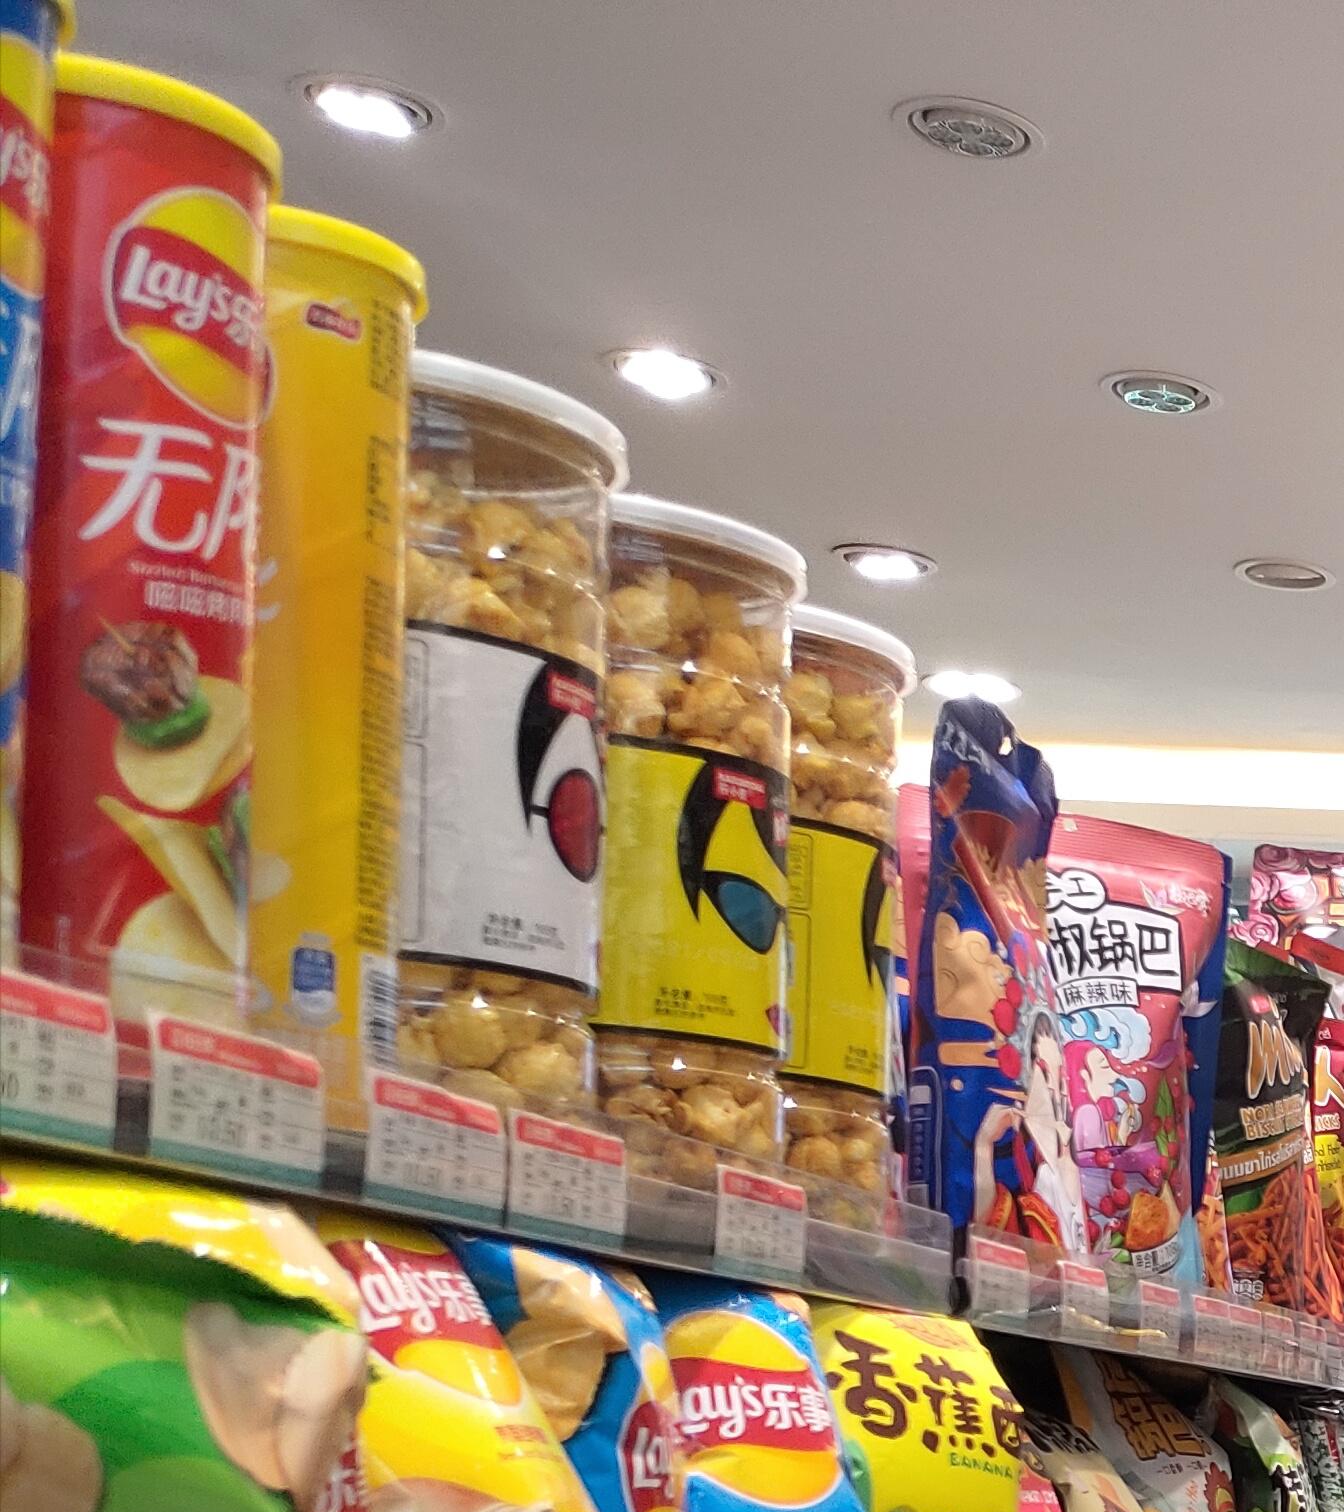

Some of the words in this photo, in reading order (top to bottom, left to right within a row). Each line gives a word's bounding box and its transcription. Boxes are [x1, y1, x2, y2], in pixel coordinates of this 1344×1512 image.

[121, 242, 236, 332] Lay's
[1064, 982, 1133, 1008] 麻辣味
[949, 1452, 1014, 1481] BANANA
